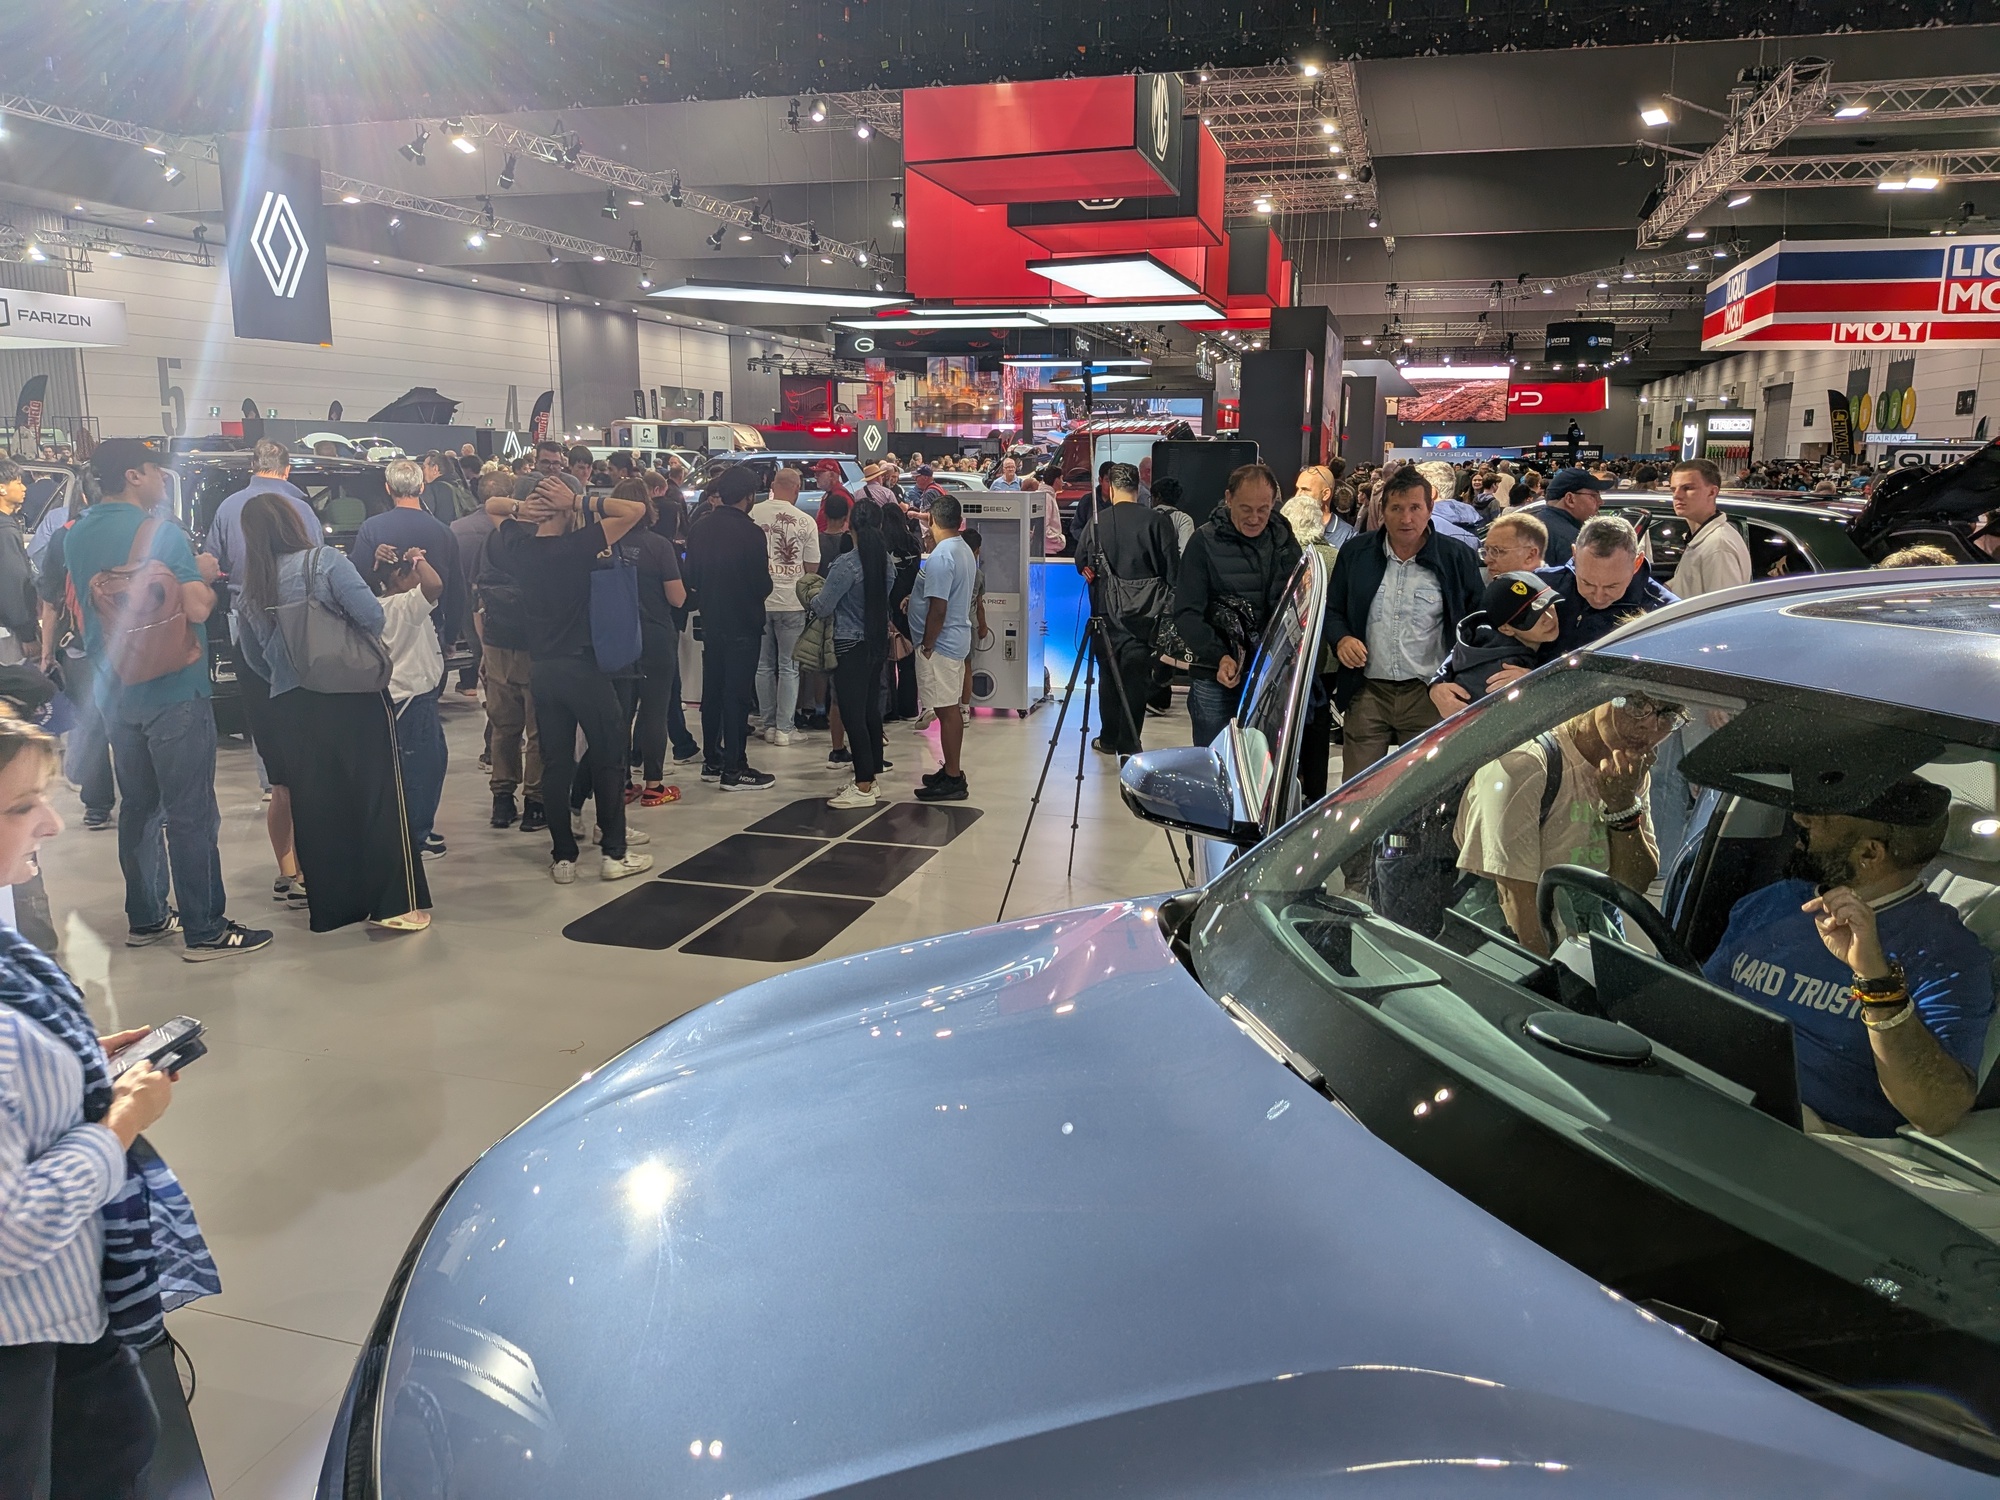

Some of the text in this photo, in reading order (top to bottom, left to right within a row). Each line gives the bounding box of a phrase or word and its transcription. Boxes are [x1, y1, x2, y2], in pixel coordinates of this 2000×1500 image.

[1727, 271, 1747, 304] LIQUI
[17, 309, 92, 327] FARIZON
[1725, 301, 1745, 332] MOLY
[1550, 336, 1570, 344] vcm
[1838, 322, 1924, 342] MOLY
[157, 356, 187, 437] 5
[1508, 391, 1543, 407] YD
[1710, 420, 1750, 430] TRICO
[1867, 434, 1915, 442] GARAGE
[769, 564, 803, 576] ADISO
[227, 934, 244, 946] N
[1730, 952, 1787, 997] HARD
